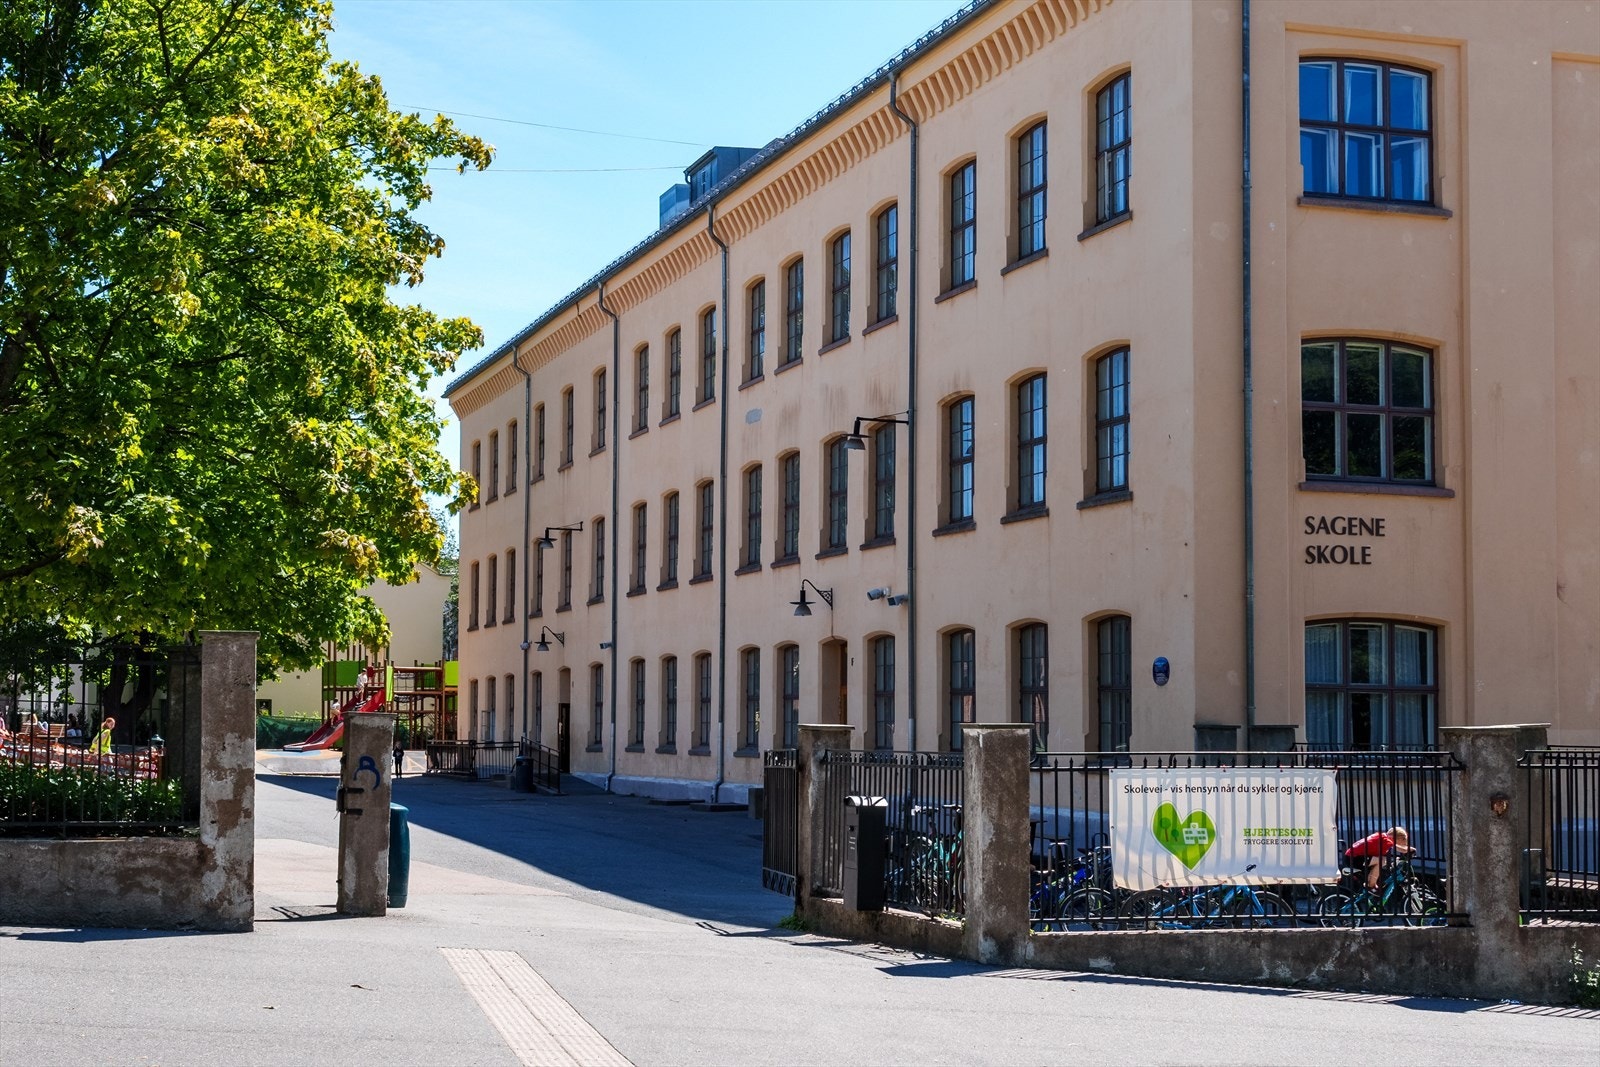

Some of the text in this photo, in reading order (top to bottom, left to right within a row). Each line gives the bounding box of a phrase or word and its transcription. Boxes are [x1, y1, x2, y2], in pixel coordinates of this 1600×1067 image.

[1304, 515, 1386, 537] SAGENE
[1304, 545, 1372, 565] SKOLE
[1123, 784, 1163, 794] Skolevei
[1170, 784, 1183, 793] vis
[1185, 784, 1219, 795] hensyn
[1220, 783, 1235, 793] når
[1237, 783, 1250, 793] du
[1251, 783, 1279, 795] sykler
[1280, 785, 1292, 795] og
[1294, 784, 1324, 795] kjører.
[1243, 828, 1314, 837] HJERTESONE
[1243, 838, 1314, 846] TRYGGERE SKOLEVEI
